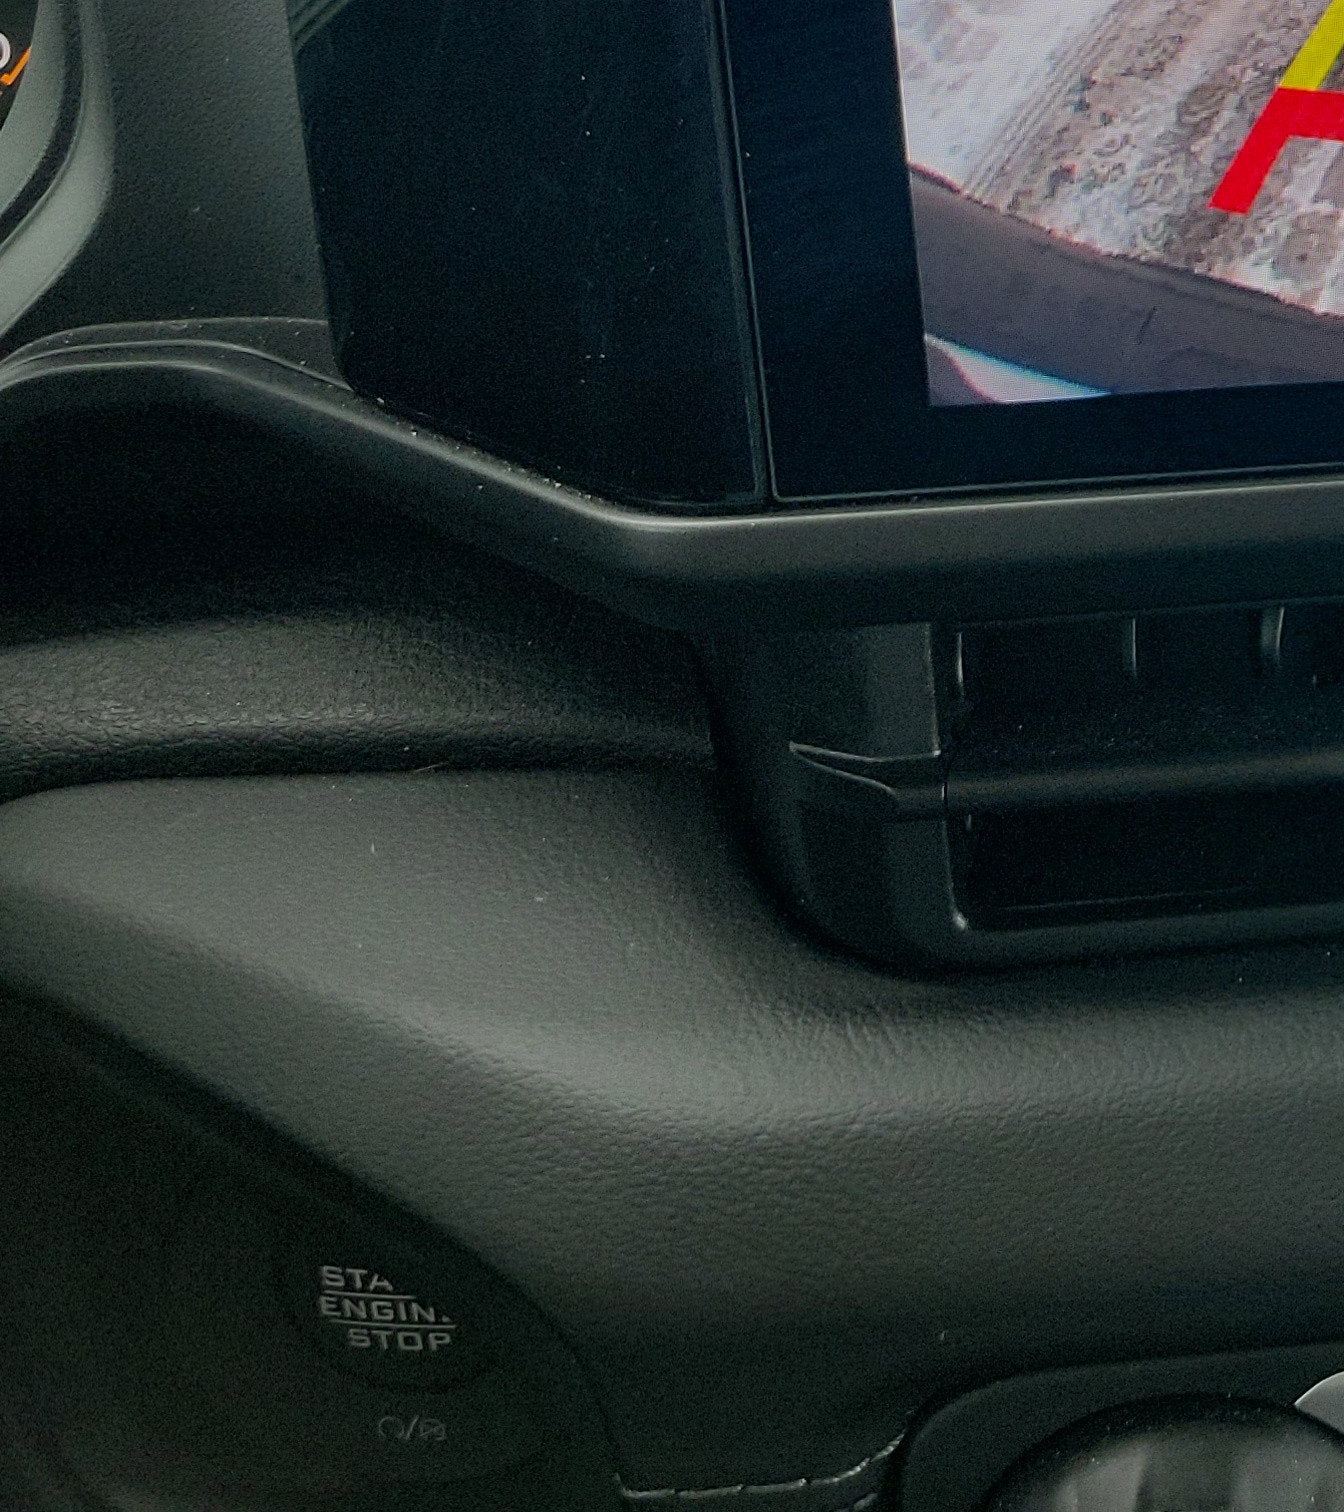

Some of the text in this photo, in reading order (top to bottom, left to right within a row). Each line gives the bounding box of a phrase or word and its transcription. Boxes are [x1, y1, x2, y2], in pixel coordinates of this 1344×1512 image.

[320, 1265, 394, 1292] STA
[319, 1295, 453, 1323] ENGIN
[348, 1328, 452, 1351] STOP
